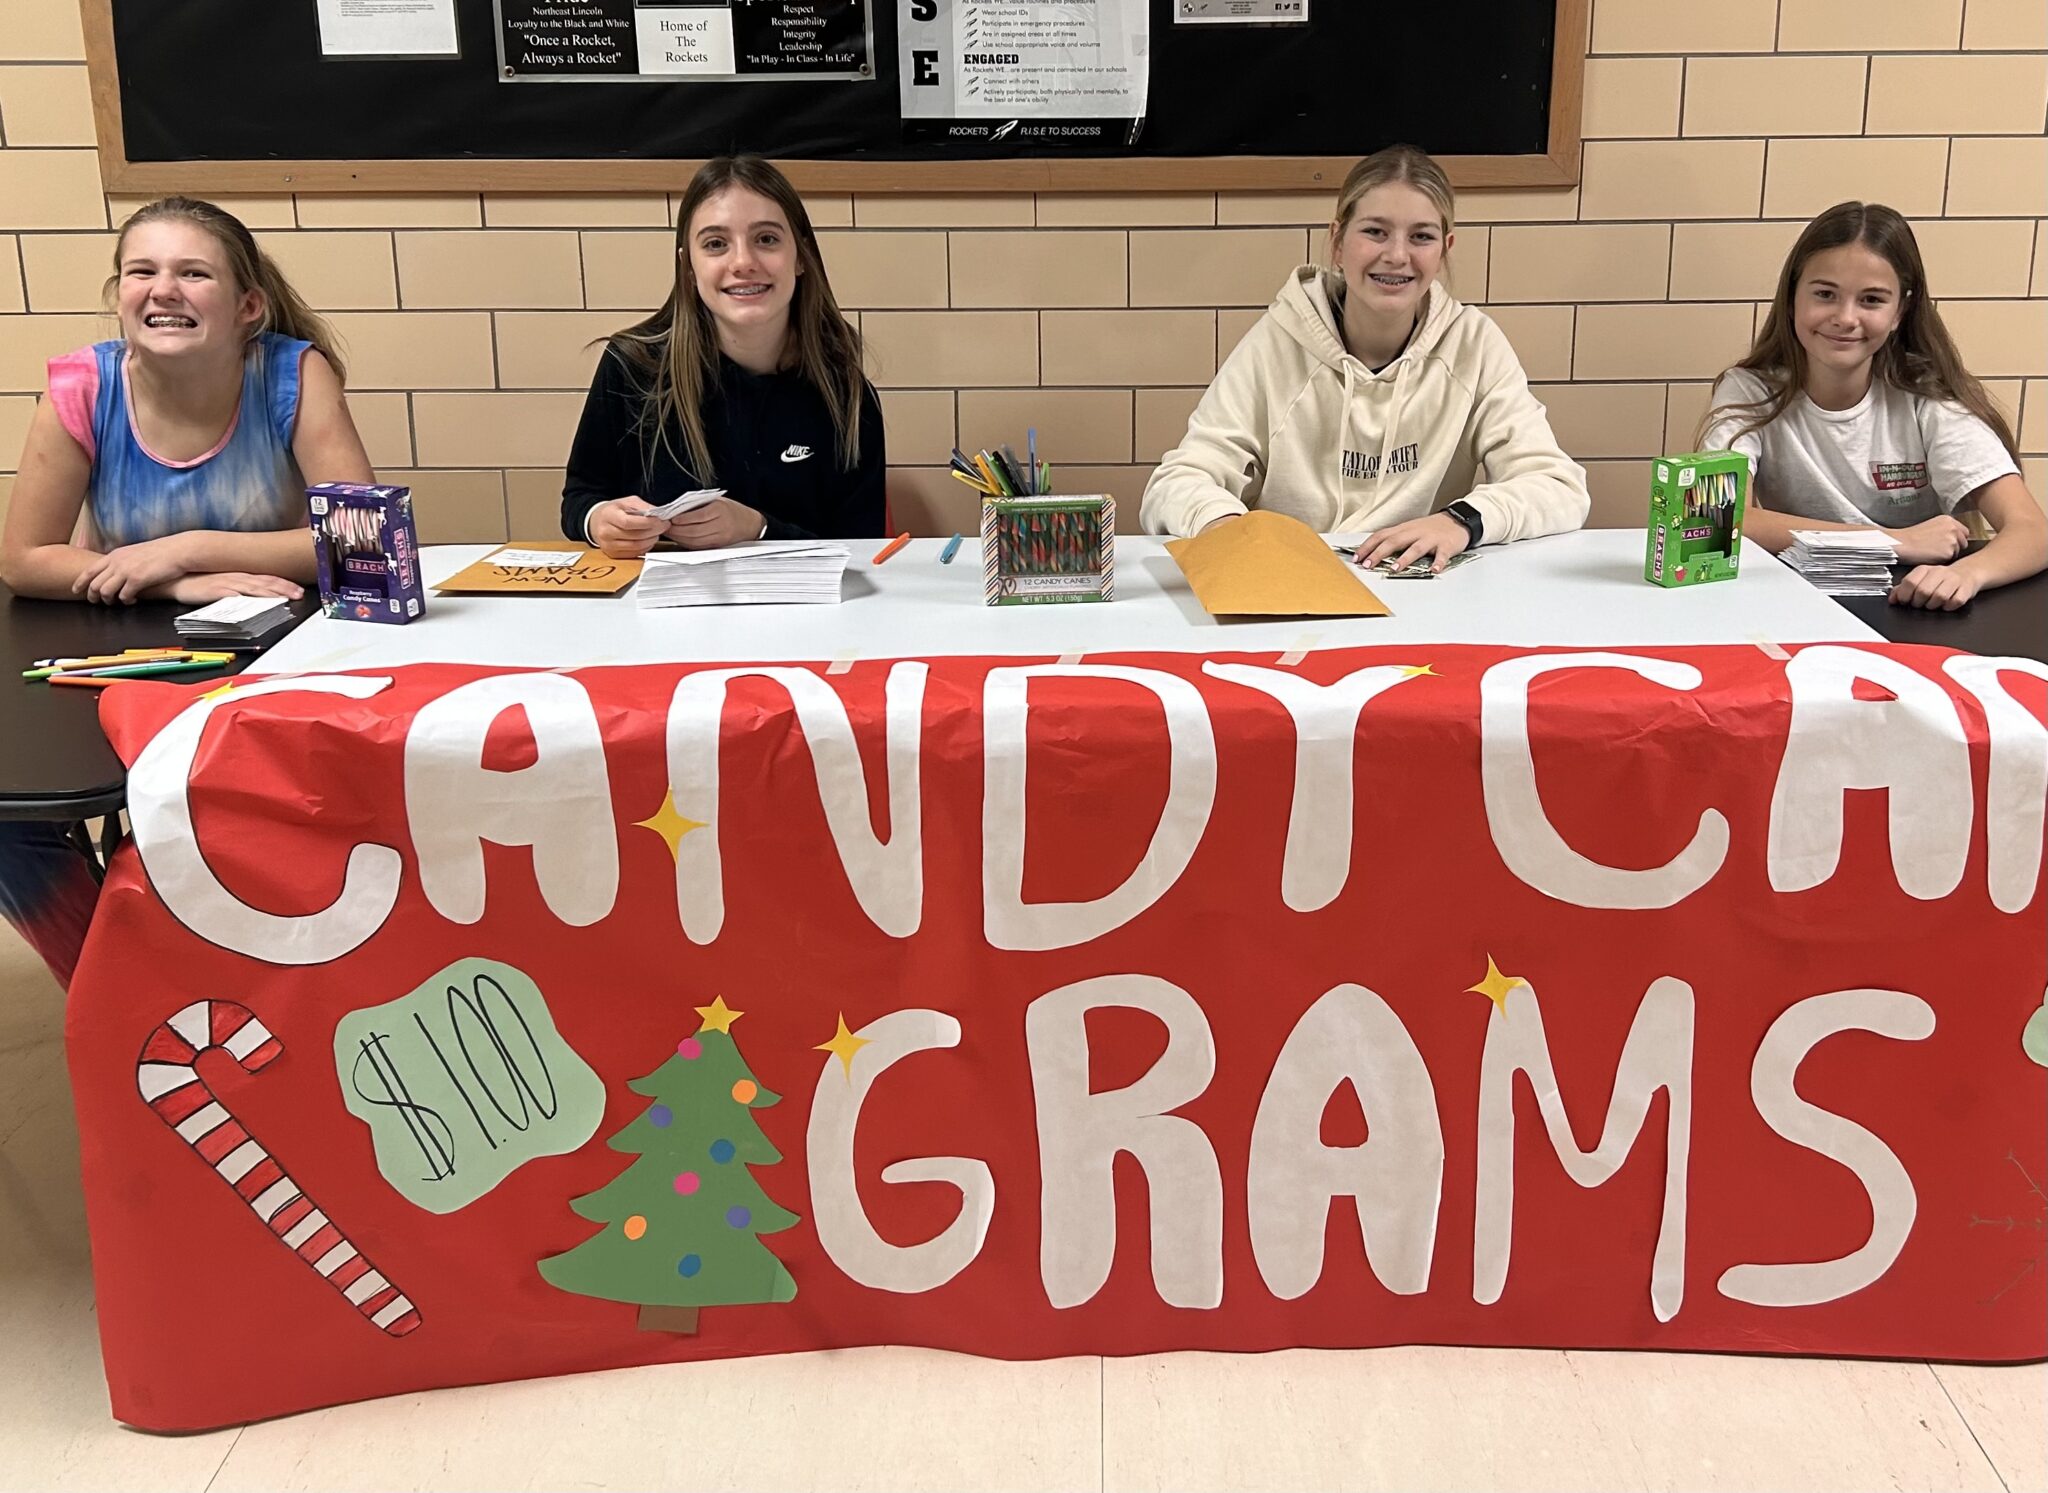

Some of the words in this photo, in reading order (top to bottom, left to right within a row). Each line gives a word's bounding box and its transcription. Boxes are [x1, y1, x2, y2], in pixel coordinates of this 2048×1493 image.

[532, 6, 570, 16] Northeast
[572, 6, 603, 16] Lincoln
[783, 5, 814, 15] Respect
[507, 19, 538, 30] Loyalty
[540, 19, 549, 28] to
[550, 19, 562, 28] the
[564, 19, 587, 28] Black
[588, 19, 603, 28] and
[605, 19, 630, 28] White
[660, 20, 694, 31] Home
[696, 20, 708, 31] of
[771, 17, 827, 27] Responsibility
[783, 30, 817, 39] Integrity
[523, 34, 559, 46] "Once
[562, 37, 569, 46] a
[572, 34, 616, 47] Rocket,
[675, 36, 697, 47] The
[779, 42, 823, 52] Leadership
[522, 52, 564, 66] Always
[567, 55, 573, 64] a
[576, 52, 622, 64] Rocket"
[665, 51, 708, 62] Rockets
[746, 54, 759, 63] "In
[761, 54, 779, 65] Play
[786, 54, 795, 63] In
[796, 54, 818, 63] Class
[825, 54, 834, 63] In
[836, 54, 855, 63] Life"
[964, 54, 1019, 64] ENGAGED
[912, 50, 939, 86] E
[949, 127, 989, 135] ROCKETS
[1049, 127, 1060, 135] TO
[1060, 127, 1101, 135] SUCCESS
[786, 444, 811, 457] NIKE
[1388, 442, 1419, 466] WIFT
[1342, 467, 1361, 479] THE
[1391, 461, 1419, 473] TOUR
[1683, 469, 1691, 477] 12
[313, 498, 322, 506] 12
[1682, 527, 1712, 538] RACHS
[347, 561, 385, 572] BRACH
[127, 659, 1417, 966] CANDY
[1480, 645, 2048, 914] CA
[353, 974, 557, 1181] $1.00
[806, 973, 1937, 1323] GRAMS
